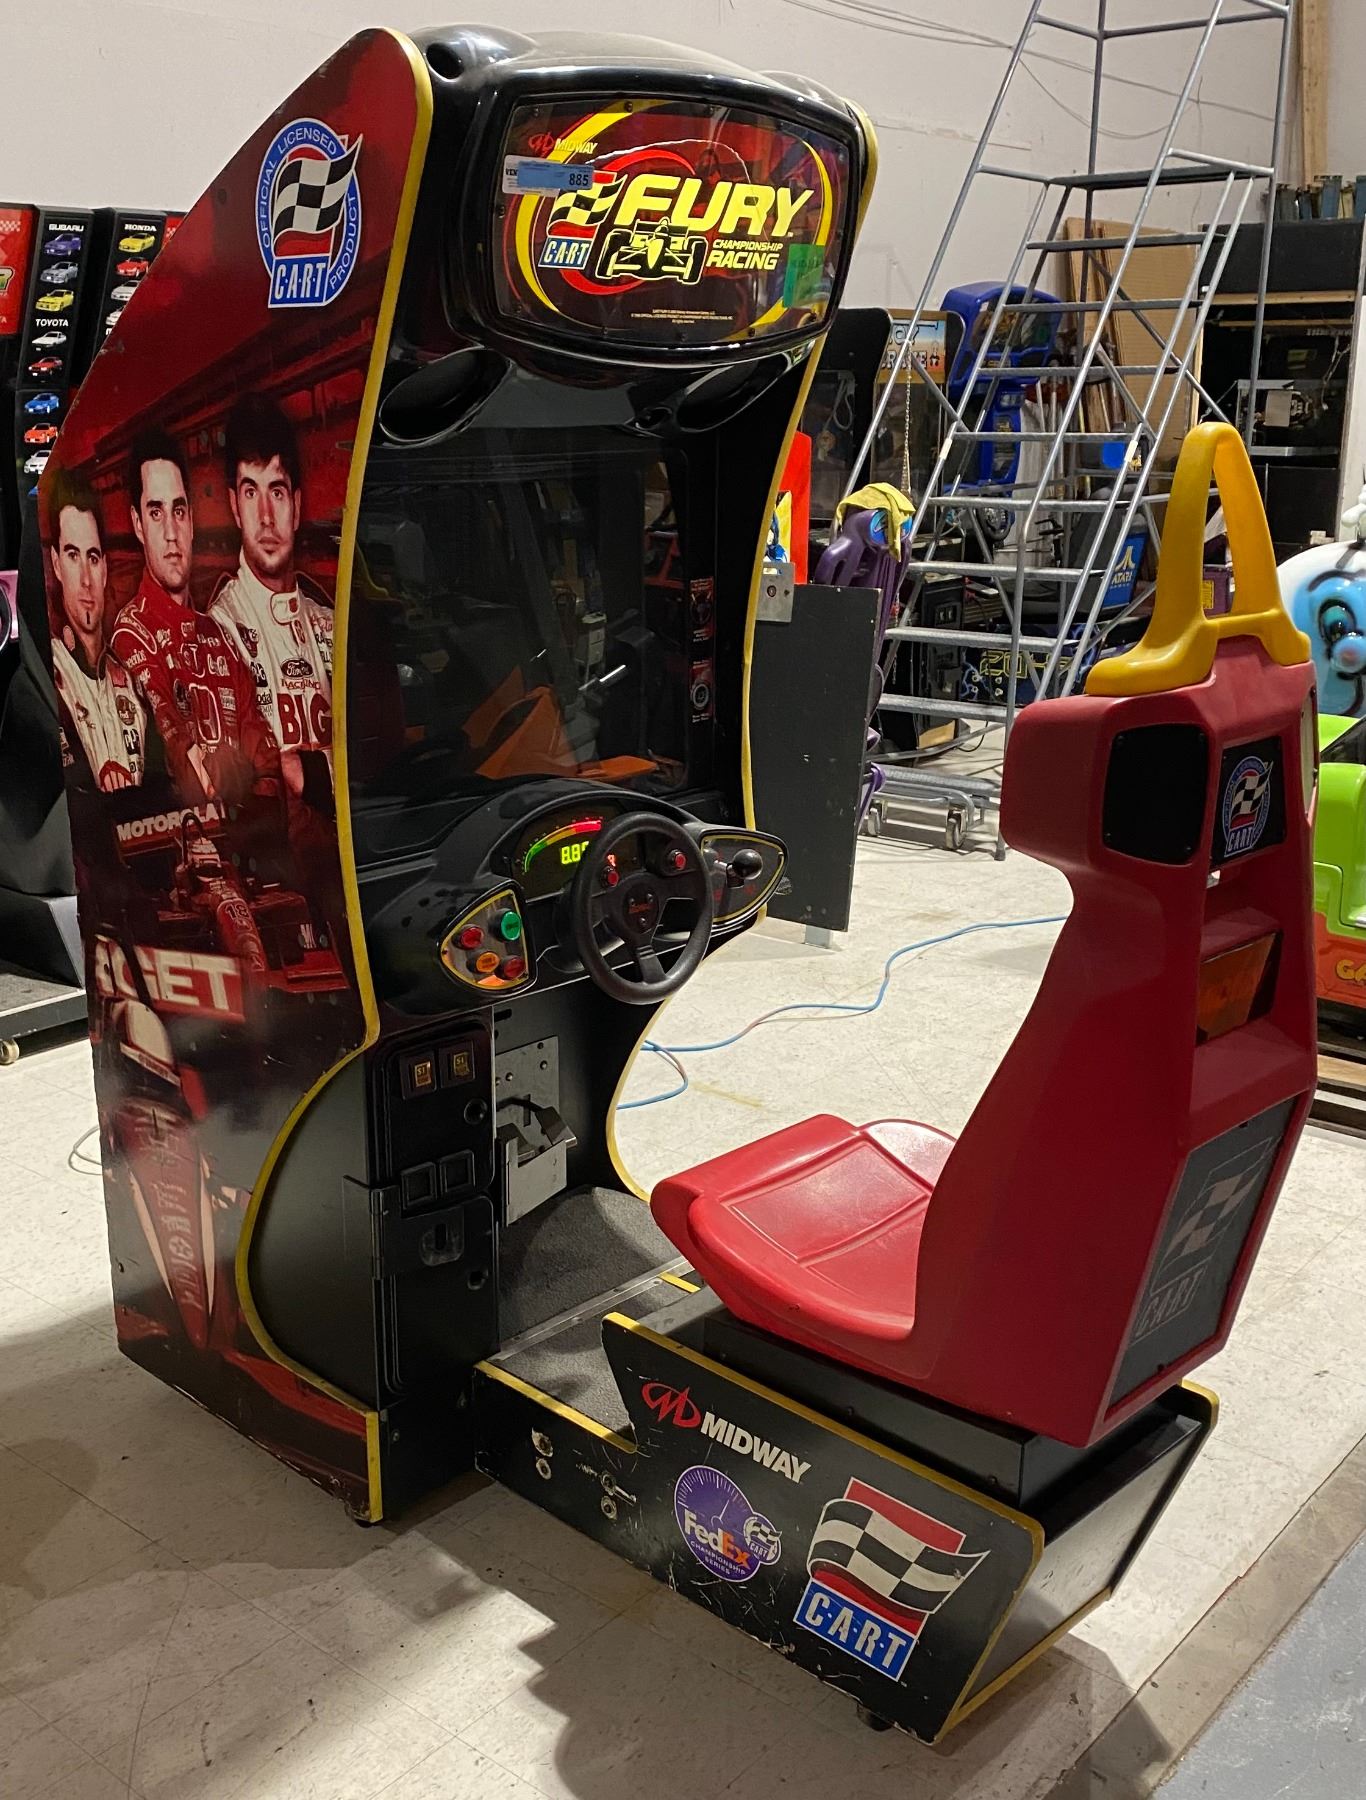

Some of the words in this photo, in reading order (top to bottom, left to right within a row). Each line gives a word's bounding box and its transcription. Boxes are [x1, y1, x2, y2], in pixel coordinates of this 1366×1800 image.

[277, 127, 337, 156] LICENSED
[553, 138, 598, 154] MIDWAY
[569, 173, 589, 186] 885
[258, 159, 277, 249] OFFICIAL
[614, 173, 815, 238] FURY
[49, 223, 84, 232] SUBARU
[124, 223, 157, 232] HONDA
[329, 193, 357, 290] PRODUCT
[712, 239, 784, 251] CHAMPIONSHIP
[706, 251, 780, 271] RACING
[35, 318, 69, 327] TOYOTA
[277, 692, 333, 745] BIG
[225, 903, 249, 919] 18
[700, 1411, 811, 1483] MIDWAY
[684, 1509, 751, 1570] FedEx
[690, 1541, 746, 1575] CHAMPIONSHIP
[704, 1556, 731, 1575] SERIES
